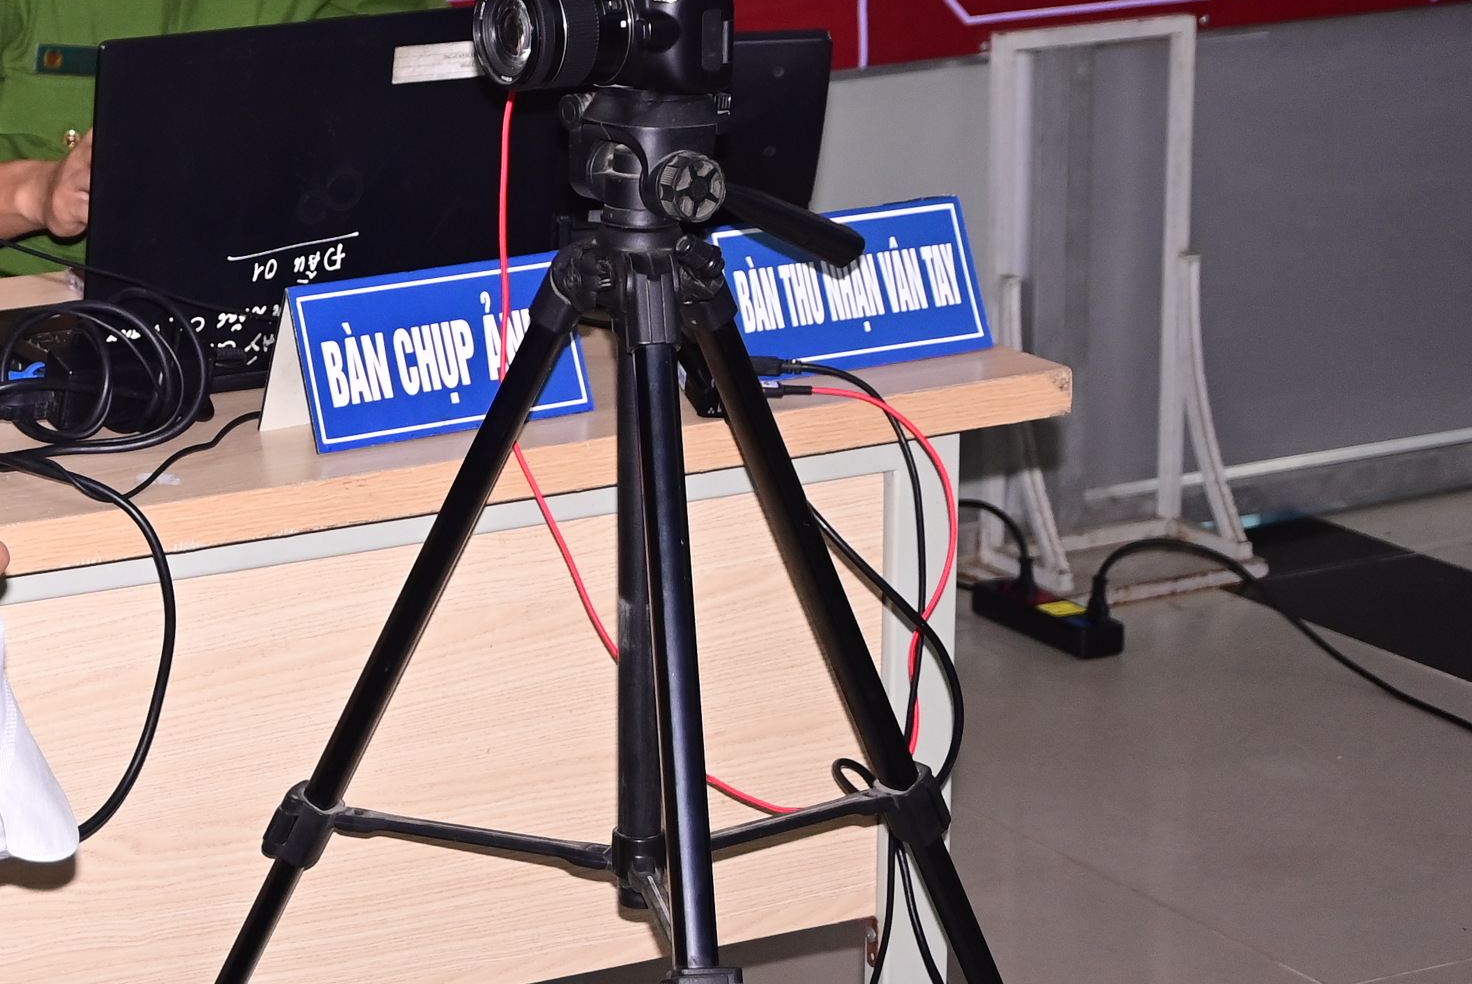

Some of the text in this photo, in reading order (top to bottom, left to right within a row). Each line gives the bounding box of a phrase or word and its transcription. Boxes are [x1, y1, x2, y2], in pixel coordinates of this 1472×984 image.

[733, 256, 785, 333] BÀN
[920, 243, 962, 307] TAY
[321, 322, 394, 408] BÀN
[393, 319, 475, 404] CHỤP
[479, 291, 531, 382] ẢN
